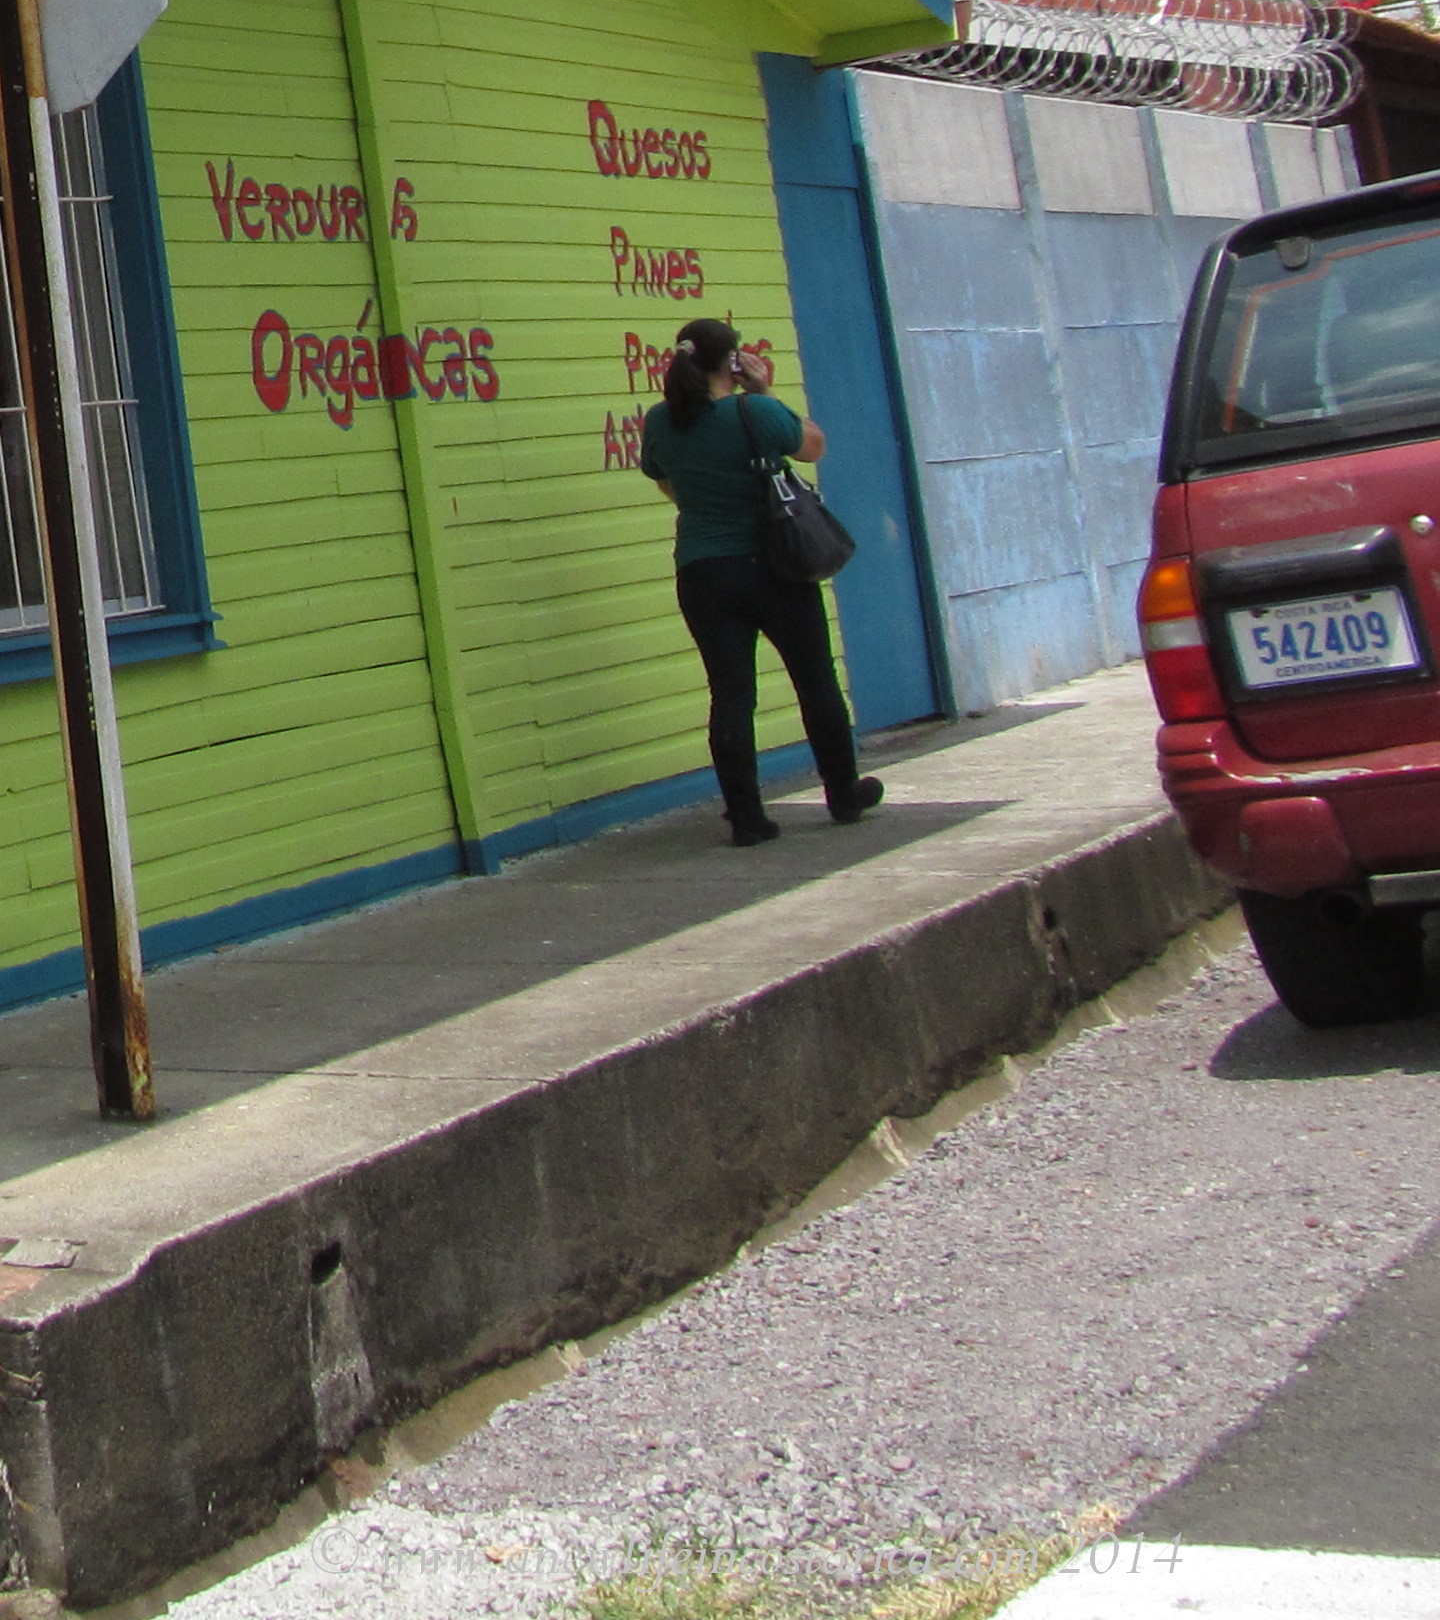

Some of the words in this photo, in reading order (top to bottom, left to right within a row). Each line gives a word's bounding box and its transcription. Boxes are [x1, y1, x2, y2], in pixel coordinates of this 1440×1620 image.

[1276, 605, 1317, 619] COSTA
[1321, 601, 1353, 613] RICA
[1253, 611, 1390, 664] 542409
[1276, 656, 1382, 677] CENTROAMERICA
